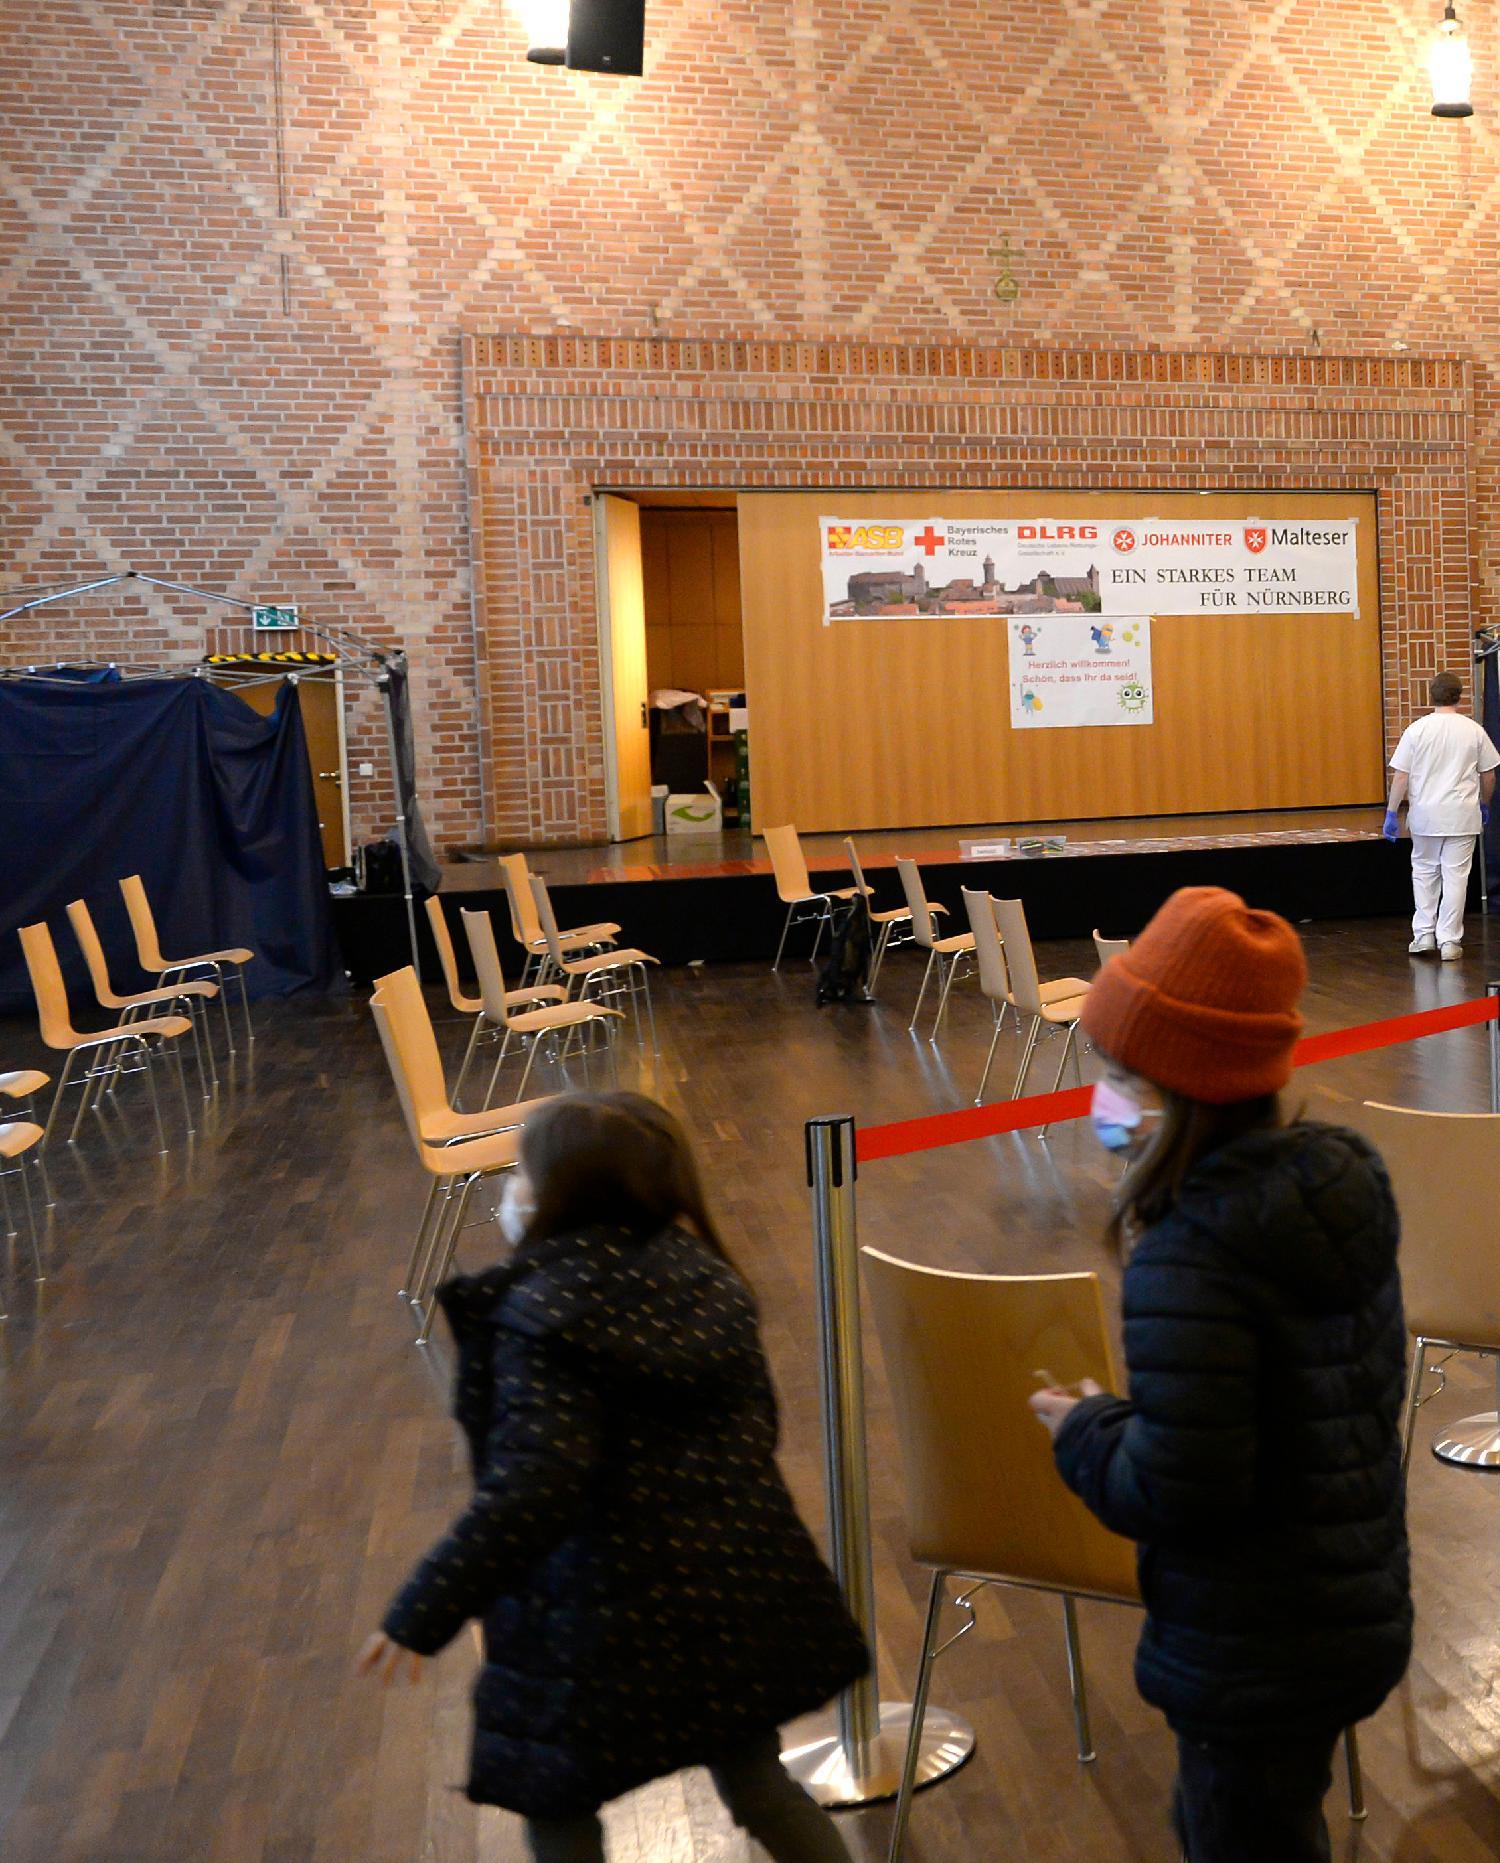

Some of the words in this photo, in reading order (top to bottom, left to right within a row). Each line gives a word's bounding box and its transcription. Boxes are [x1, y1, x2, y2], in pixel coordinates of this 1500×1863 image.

[848, 525, 904, 548] ASB
[947, 526, 1009, 537] Bayerisches
[1017, 526, 1098, 539] DLRG
[1271, 528, 1348, 545] Malteser
[947, 537, 977, 546] Rotes
[1141, 533, 1232, 546] JOHANNITER
[948, 548, 977, 557] Kreuz
[1111, 569, 1146, 584] EIN
[1156, 568, 1235, 583] STARKES
[1244, 568, 1297, 582] TEAM
[1199, 588, 1237, 606] FÜR
[1246, 588, 1351, 606] NÜRNBERG
[1028, 660, 1068, 669] Herzlich
[1070, 659, 1130, 668] willkommen!
[1022, 674, 1057, 684] Schön,
[1059, 674, 1082, 683] dass
[1084, 674, 1097, 682] Ihr
[1100, 673, 1112, 682] da
[1114, 672, 1138, 681] seid!
